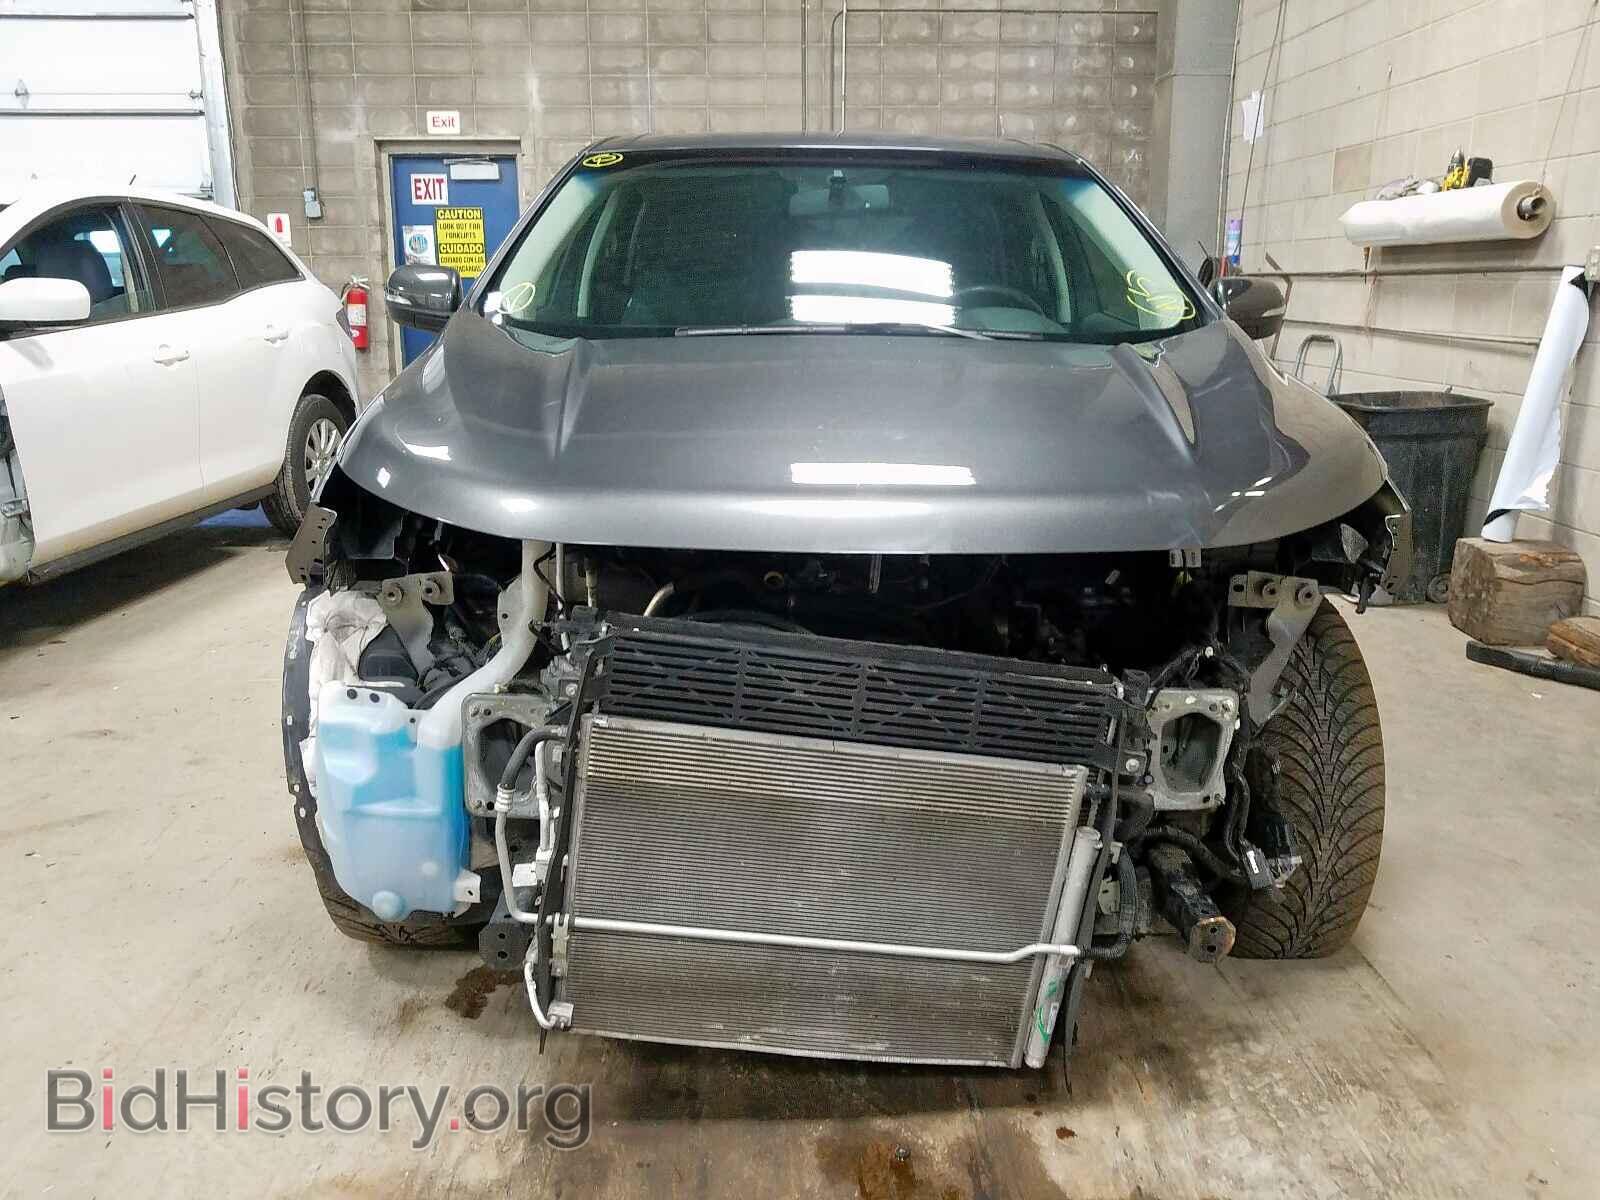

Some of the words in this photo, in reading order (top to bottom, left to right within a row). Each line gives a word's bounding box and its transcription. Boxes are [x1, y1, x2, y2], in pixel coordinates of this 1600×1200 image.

[432, 114, 455, 128] Exit
[414, 178, 444, 200] EXIT
[437, 209, 481, 219] CAUTION
[440, 243, 483, 253] CUIDADO
